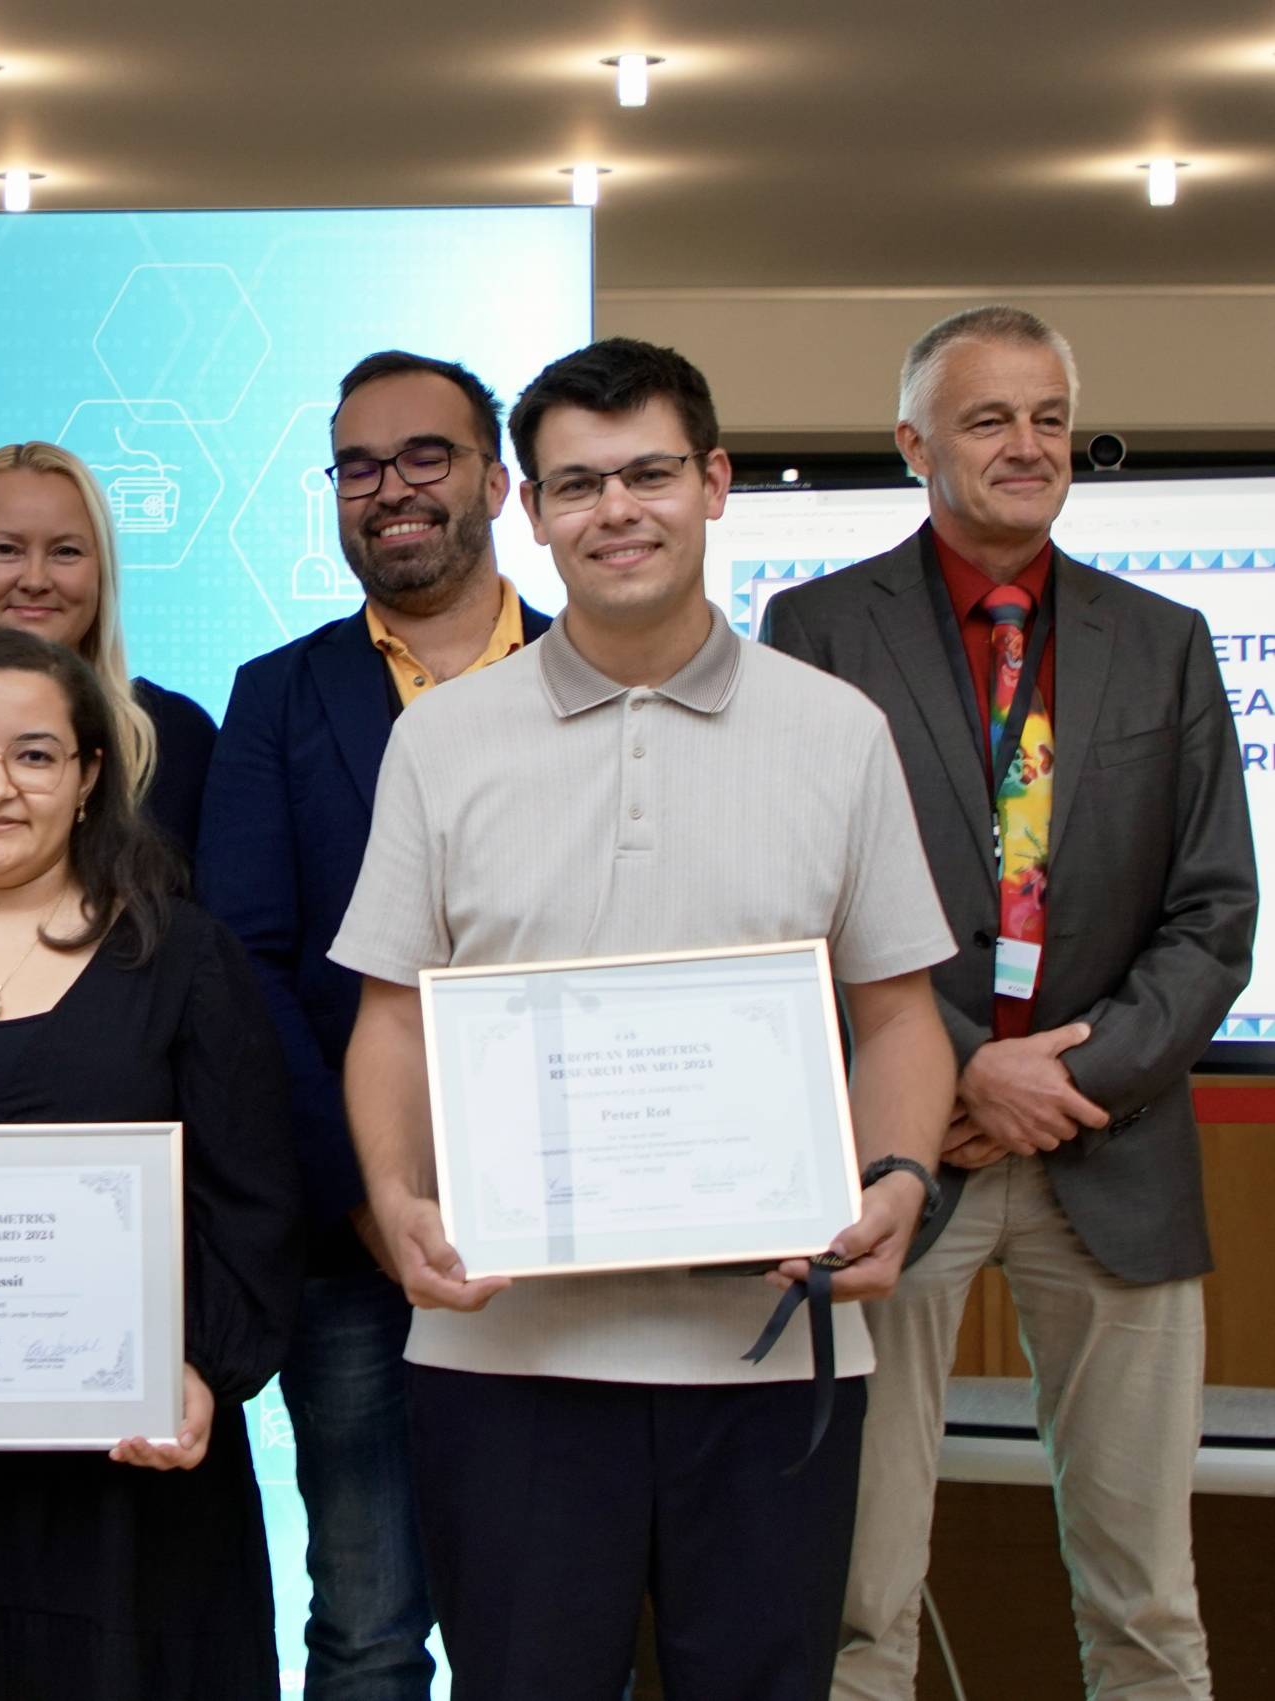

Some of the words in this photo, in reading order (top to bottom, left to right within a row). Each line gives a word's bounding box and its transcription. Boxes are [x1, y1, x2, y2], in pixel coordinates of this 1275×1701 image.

[548, 1051, 623, 1064] EUROPEAN
[627, 1043, 712, 1059] BIOMETRICS
[550, 1066, 623, 1080] RESEARCH
[629, 1062, 679, 1075] AWARD
[683, 1060, 714, 1071] 2024
[601, 1109, 641, 1122] Peter
[646, 1106, 671, 1119] Rot
[24, 1230, 54, 1241] 2024
